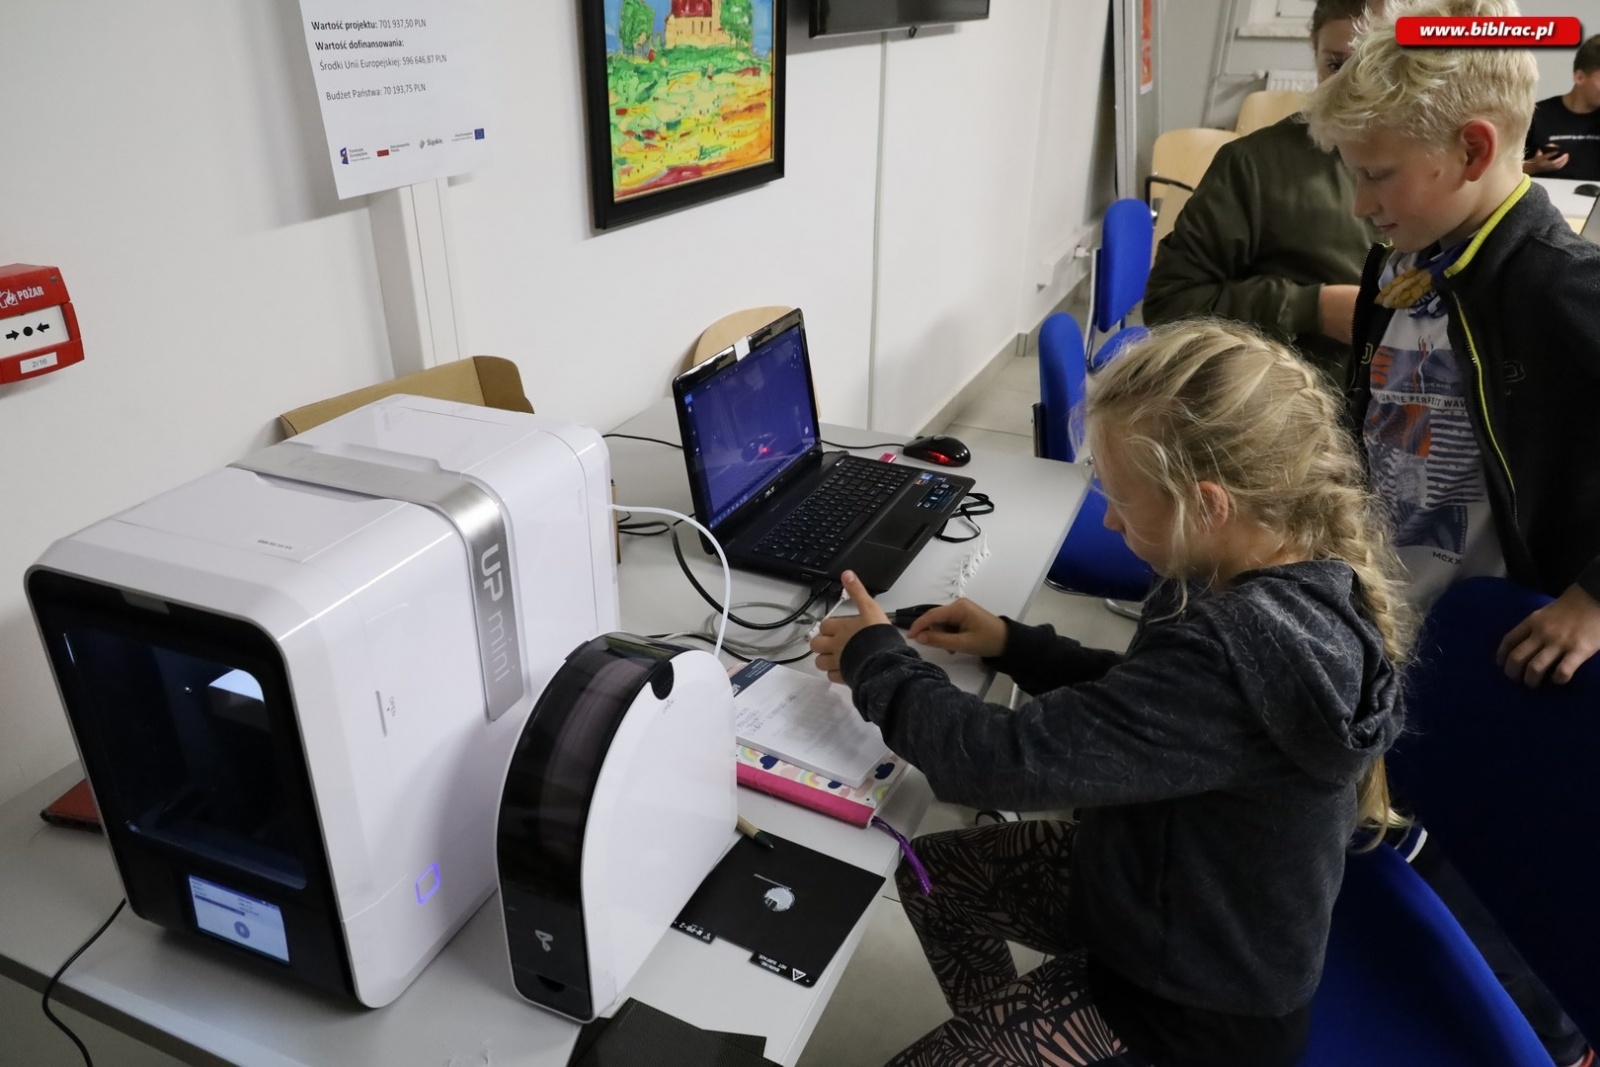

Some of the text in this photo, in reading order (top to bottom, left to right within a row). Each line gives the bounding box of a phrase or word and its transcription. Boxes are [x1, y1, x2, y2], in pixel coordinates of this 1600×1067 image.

[311, 19, 427, 31] Wartość projektu: 701 937,50 PLN
[315, 38, 405, 51] Wartość dofinansowania:
[320, 60, 343, 71] Środki
[344, 60, 359, 70] Unii
[361, 57, 402, 69] Europejskiej:
[402, 56, 414, 66] 596
[435, 54, 447, 64] PLN
[326, 90, 351, 101] Budżet
[352, 87, 383, 99] Państwa:
[383, 86, 392, 96] 70
[414, 83, 427, 93] PLN
[17, 286, 44, 300] POŻAR
[481, 543, 517, 683] UP mini
